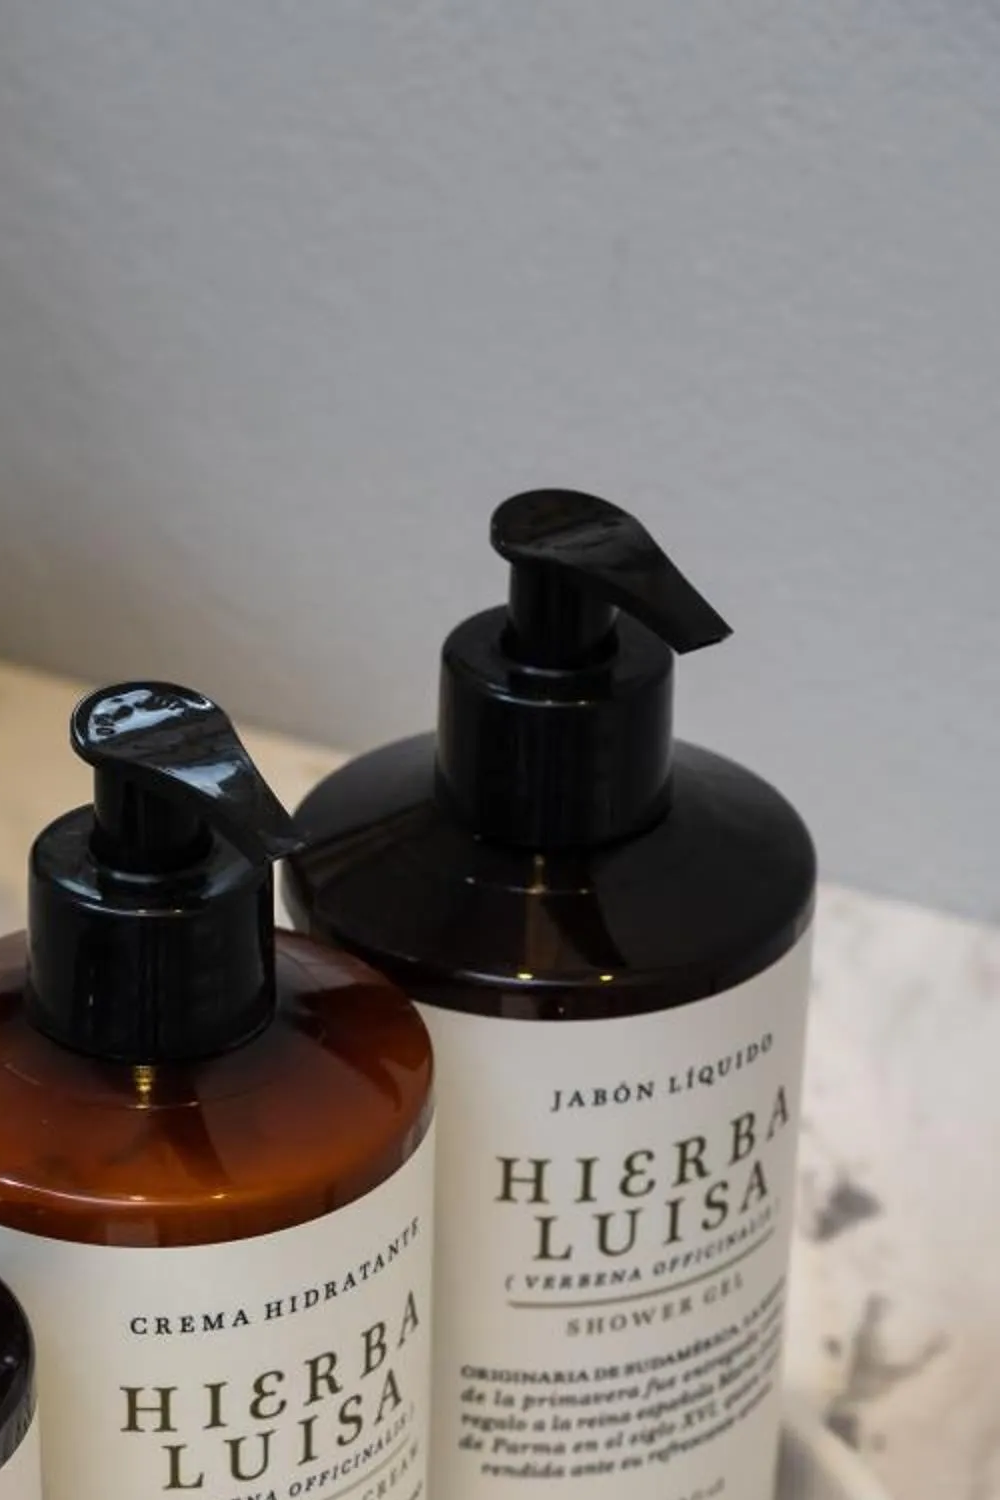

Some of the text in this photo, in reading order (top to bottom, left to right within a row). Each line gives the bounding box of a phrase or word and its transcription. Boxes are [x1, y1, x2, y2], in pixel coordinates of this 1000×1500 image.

[550, 1032, 774, 1112] JABÓN LÍQUIDO
[494, 1085, 790, 1204] HIERBA
[533, 1159, 768, 1261] LUISA
[130, 1216, 419, 1336] CREMA HIDRATANTE
[566, 1296, 694, 1337] SHOWER
[702, 1272, 744, 1306] GEL
[119, 1289, 419, 1432] HIERBA
[460, 1364, 620, 1385] ORIGINARIA DE
[460, 1372, 676, 1413] de la primavera fue
[161, 1368, 402, 1490] LUISA
[458, 1433, 483, 1451] de
[492, 1437, 566, 1455] Parma
[572, 1437, 598, 1452] en
[605, 1431, 623, 1451] el
[461, 1411, 526, 1434] regalo
[533, 1417, 545, 1432] a
[551, 1411, 572, 1432] la
[577, 1409, 631, 1430] reina
[481, 1460, 614, 1478] rendida ante
